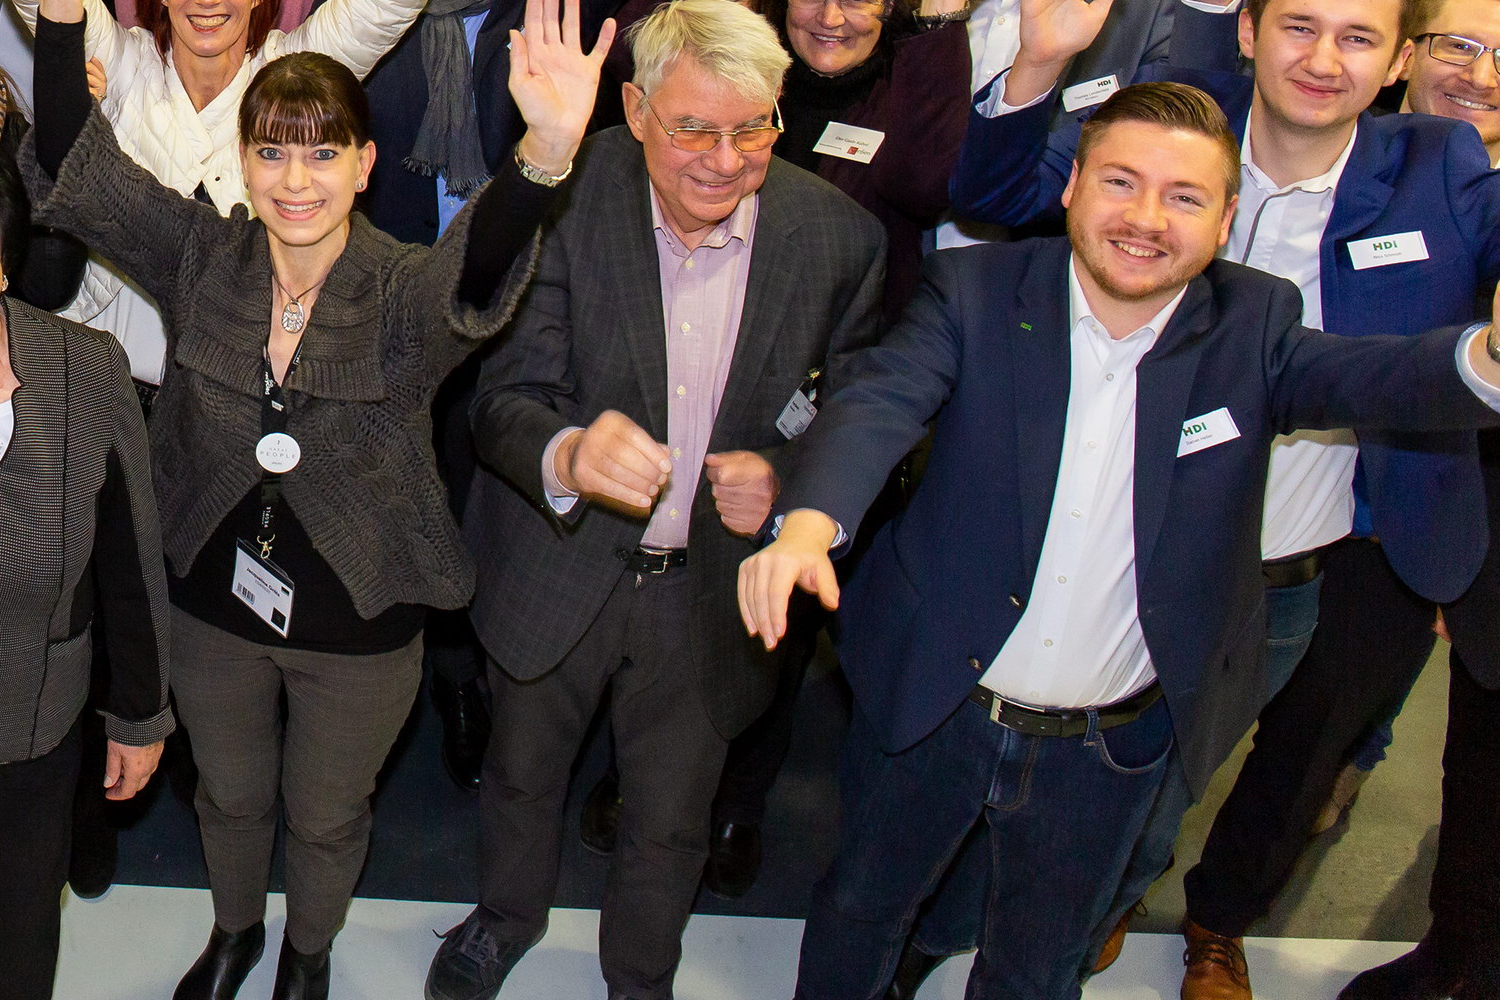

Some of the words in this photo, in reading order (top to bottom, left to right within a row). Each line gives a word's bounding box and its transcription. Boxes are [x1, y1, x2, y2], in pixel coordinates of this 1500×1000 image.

[1097, 80, 1112, 88] HDI
[1372, 240, 1398, 252] HDI
[1181, 422, 1207, 437] HDI
[260, 450, 296, 459] PEOPLE
